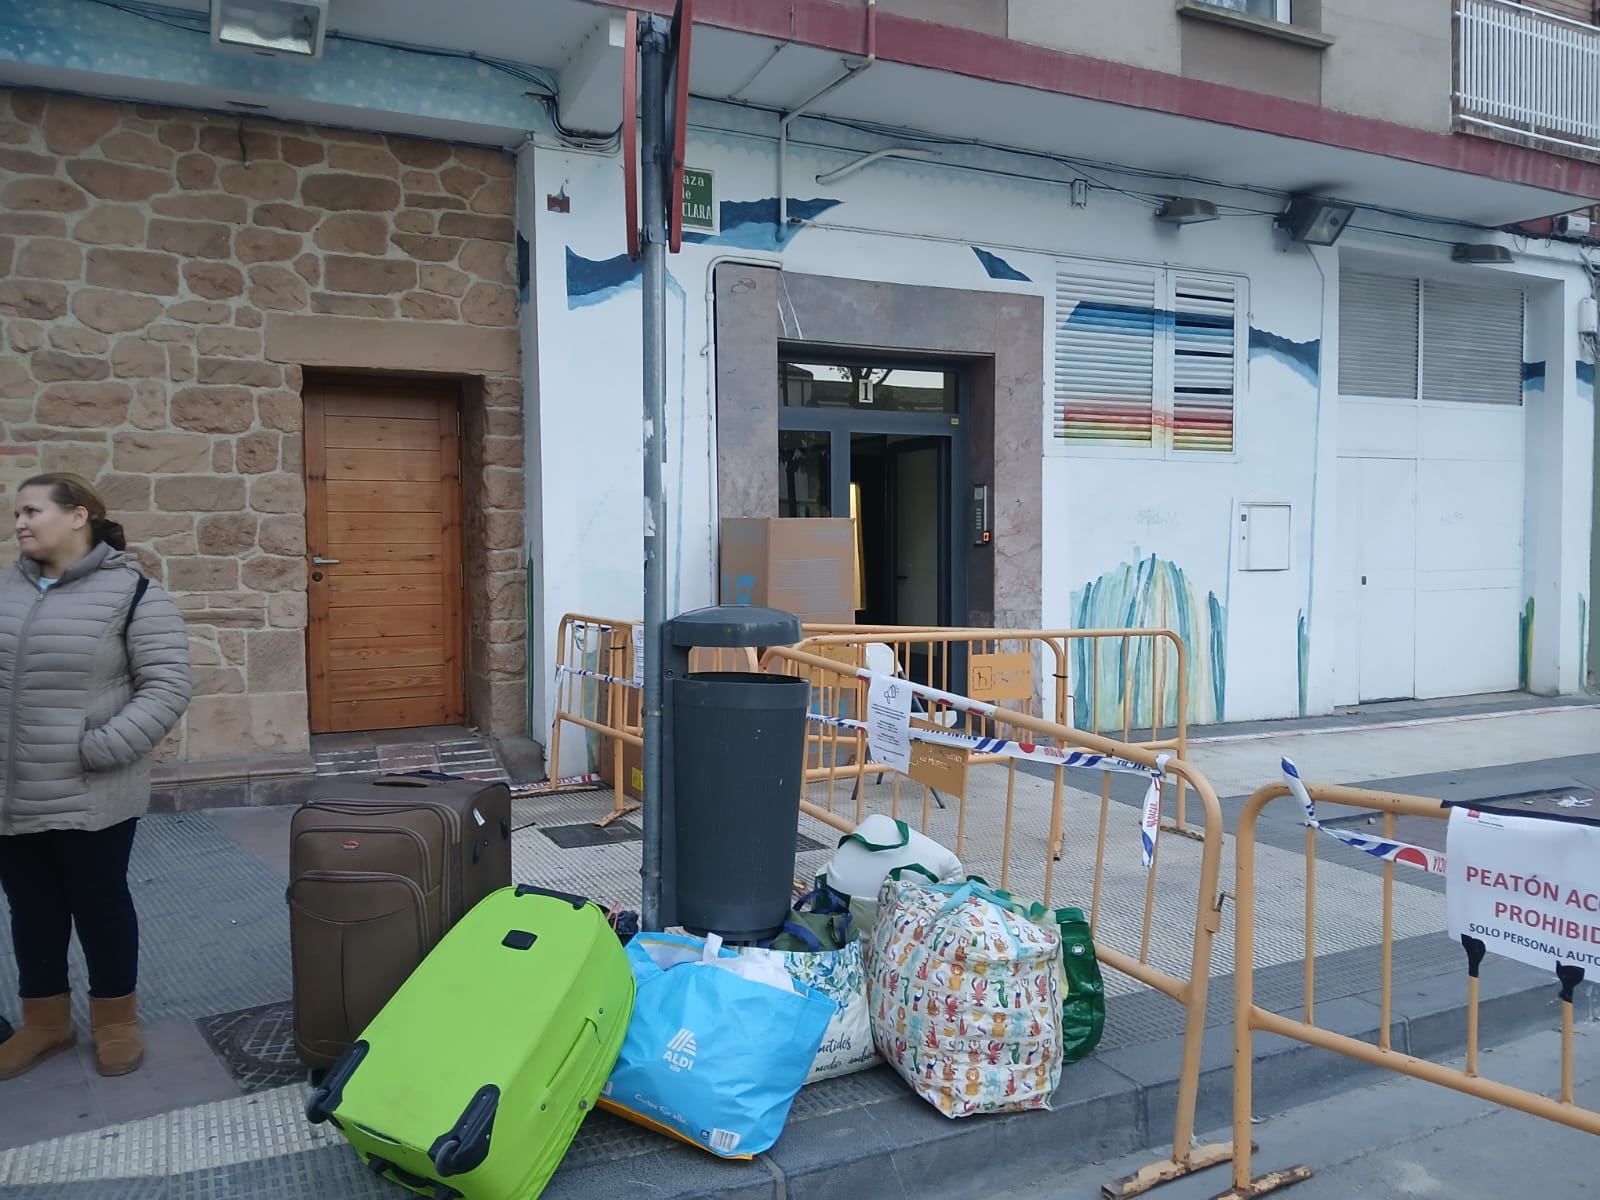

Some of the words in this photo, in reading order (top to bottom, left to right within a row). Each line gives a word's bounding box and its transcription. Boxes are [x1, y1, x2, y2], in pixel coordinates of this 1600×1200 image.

[682, 202, 712, 219] CLARA
[1465, 865, 1559, 902] PEATÓN
[1565, 888, 1600, 913] AC
[1469, 923, 1500, 938] SOLO
[1503, 931, 1563, 958] PERSONAL
[663, 1050, 693, 1070] ALDI
